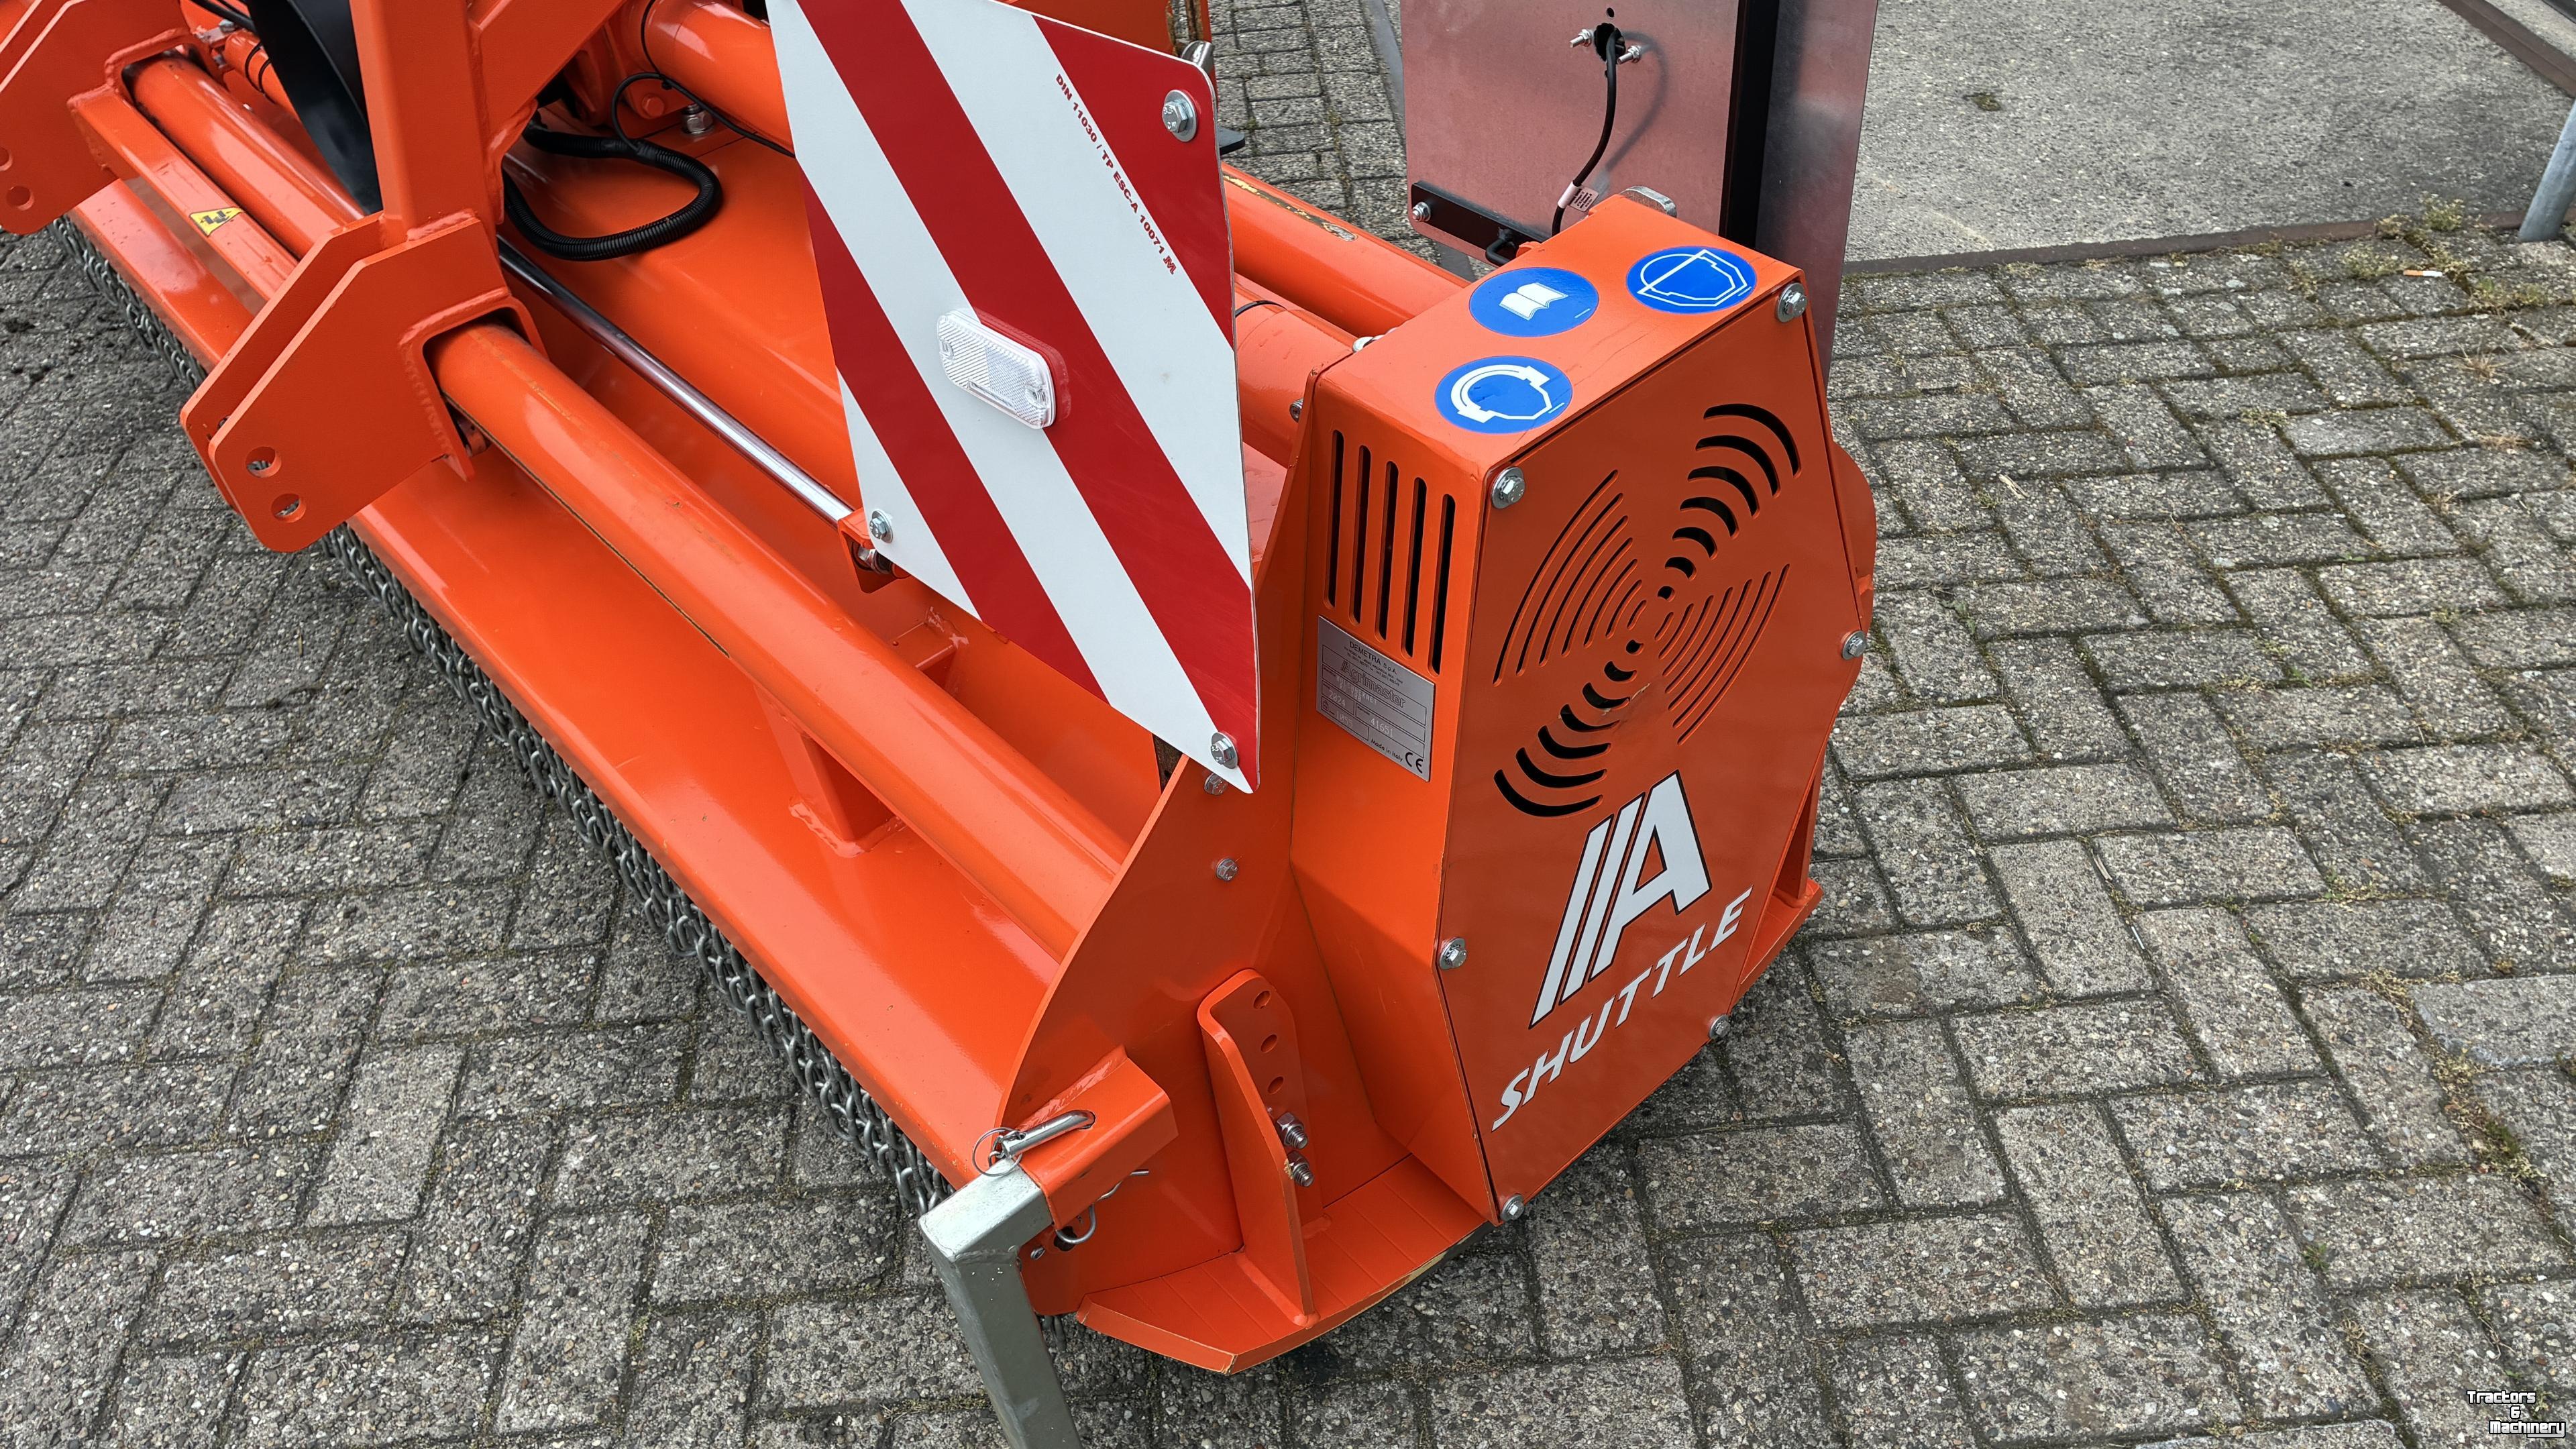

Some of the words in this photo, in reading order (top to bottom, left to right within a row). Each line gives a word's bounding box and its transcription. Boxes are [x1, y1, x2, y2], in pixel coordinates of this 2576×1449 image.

[1056, 74, 1073, 100] DIN
[1073, 102, 1097, 142] 11030
[1102, 150, 1114, 169] TP
[1113, 171, 1138, 213] ESC-A
[1140, 215, 1165, 254] 10071
[1350, 641, 1381, 665] DEMETRA
[1371, 738, 1385, 751] Made
[1392, 750, 1403, 761] Italy
[1405, 752, 1424, 773] CE
[1491, 885, 1754, 1132] SHUTTLE
